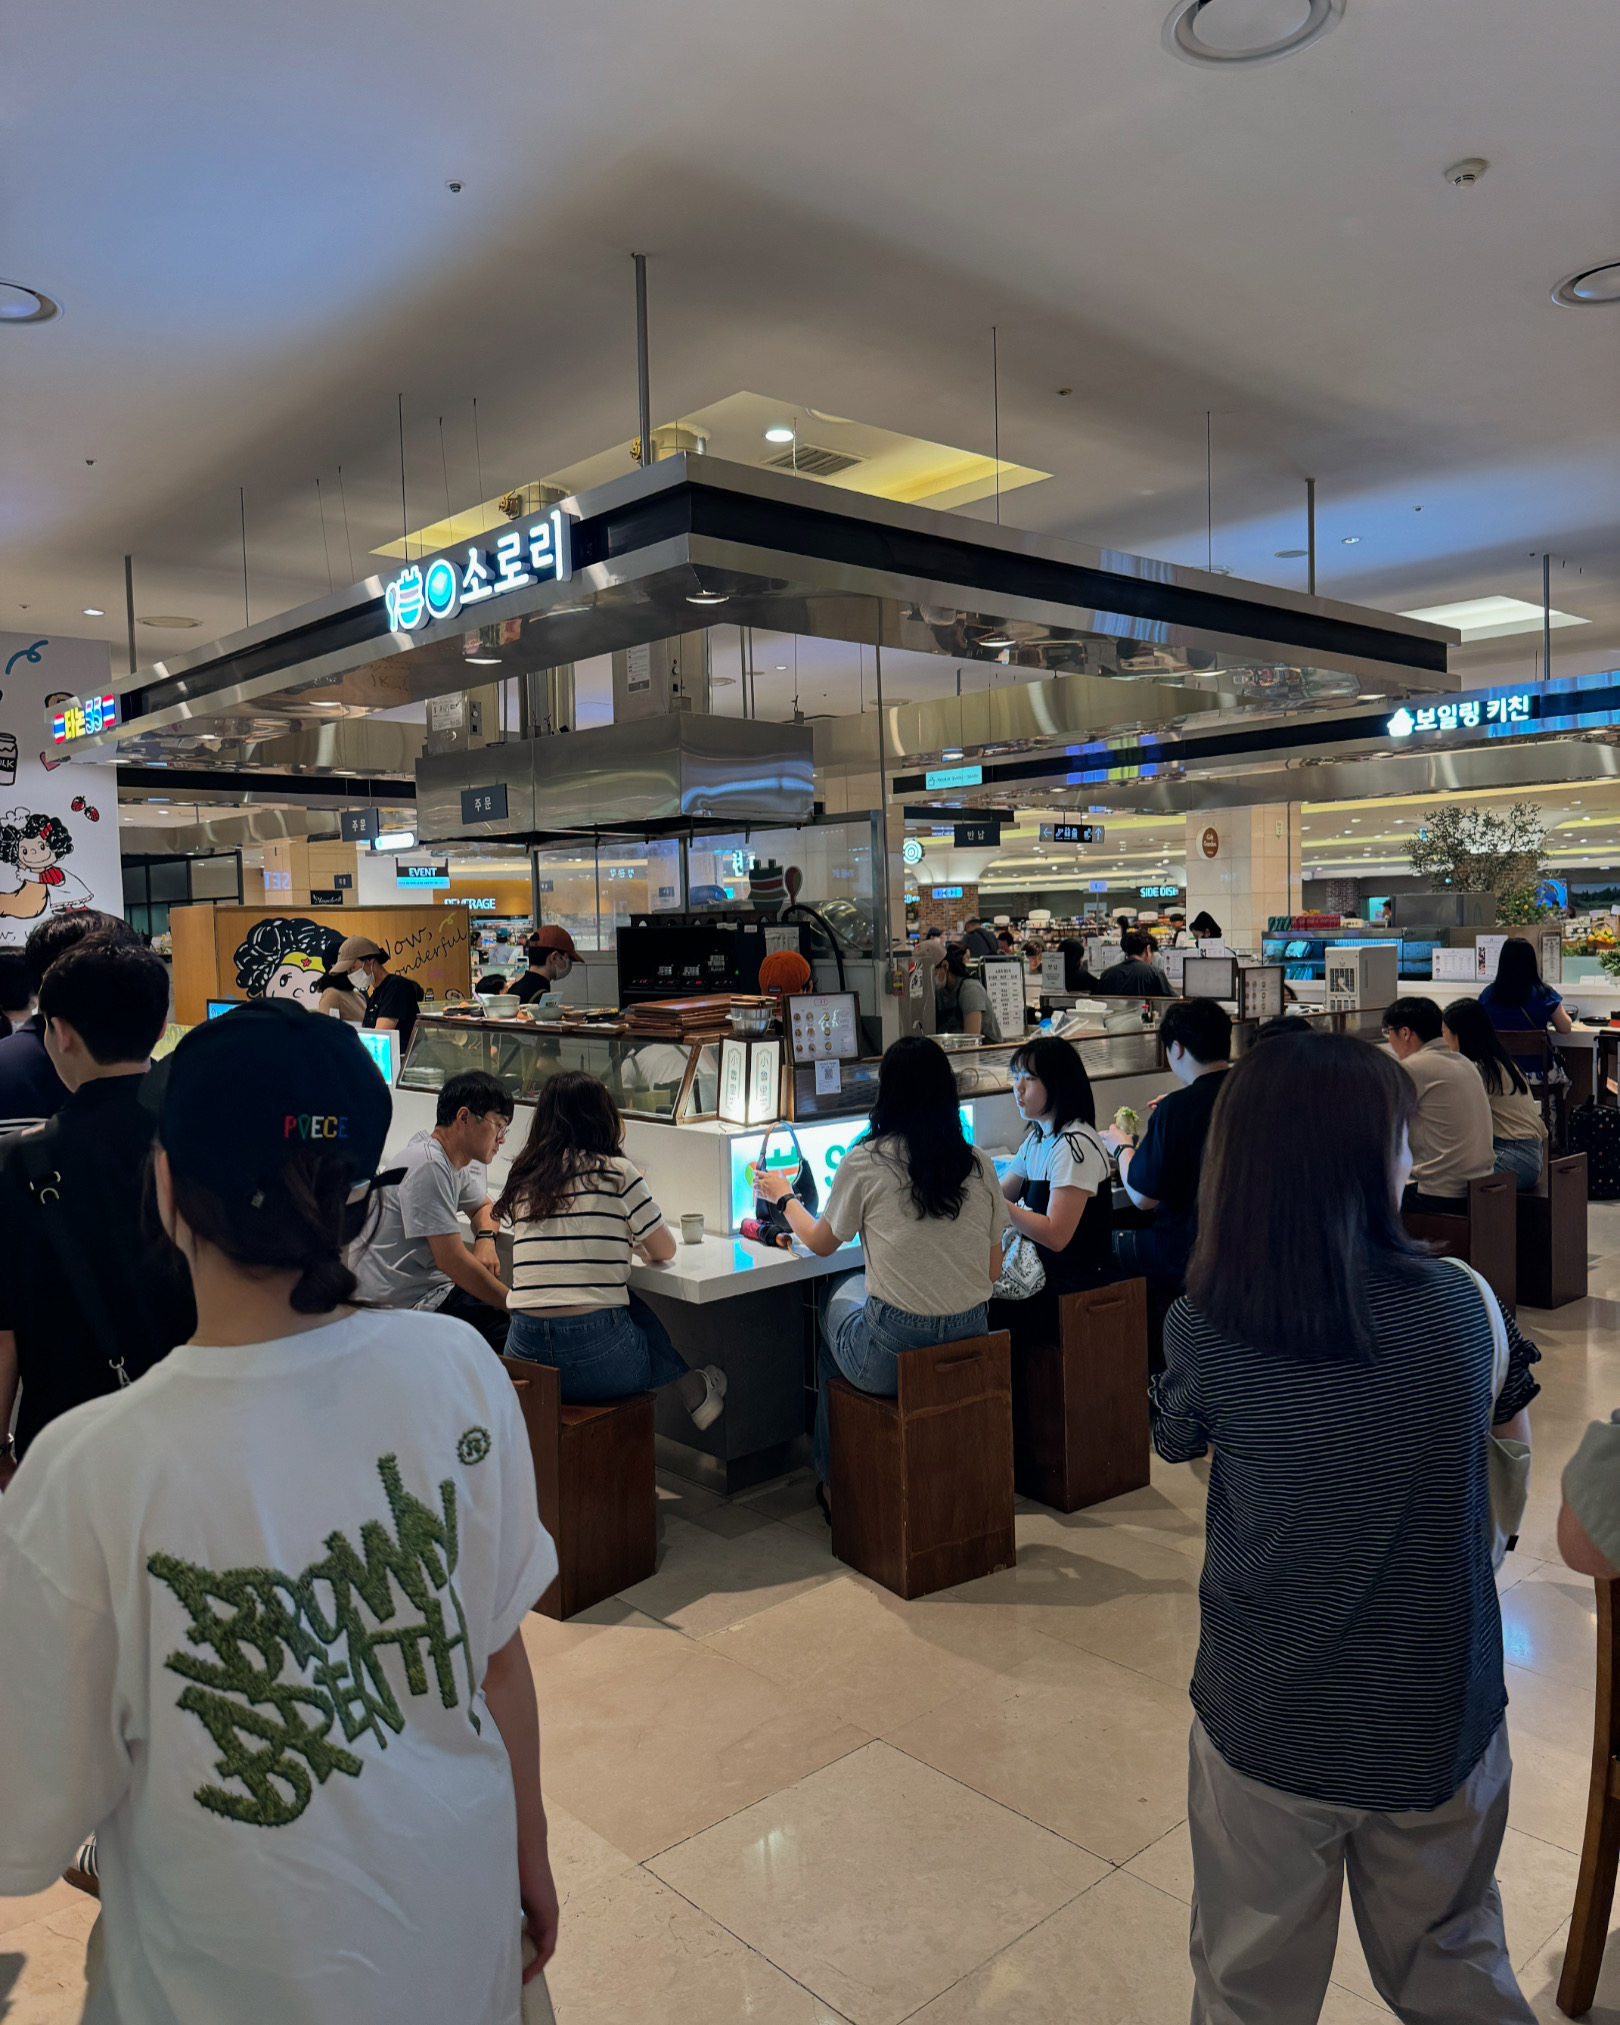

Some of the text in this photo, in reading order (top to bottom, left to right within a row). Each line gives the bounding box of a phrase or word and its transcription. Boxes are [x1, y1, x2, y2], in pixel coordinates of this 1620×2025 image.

[459, 509, 564, 605] 소로리
[1414, 695, 1530, 731] 보일링 키친
[474, 796, 491, 812] 주문
[351, 818, 366, 832] 주문
[408, 867, 437, 877] EVENT
[1140, 887, 1160, 898] SIDE
[385, 926, 433, 960] ow,
[394, 928, 468, 976] onderful
